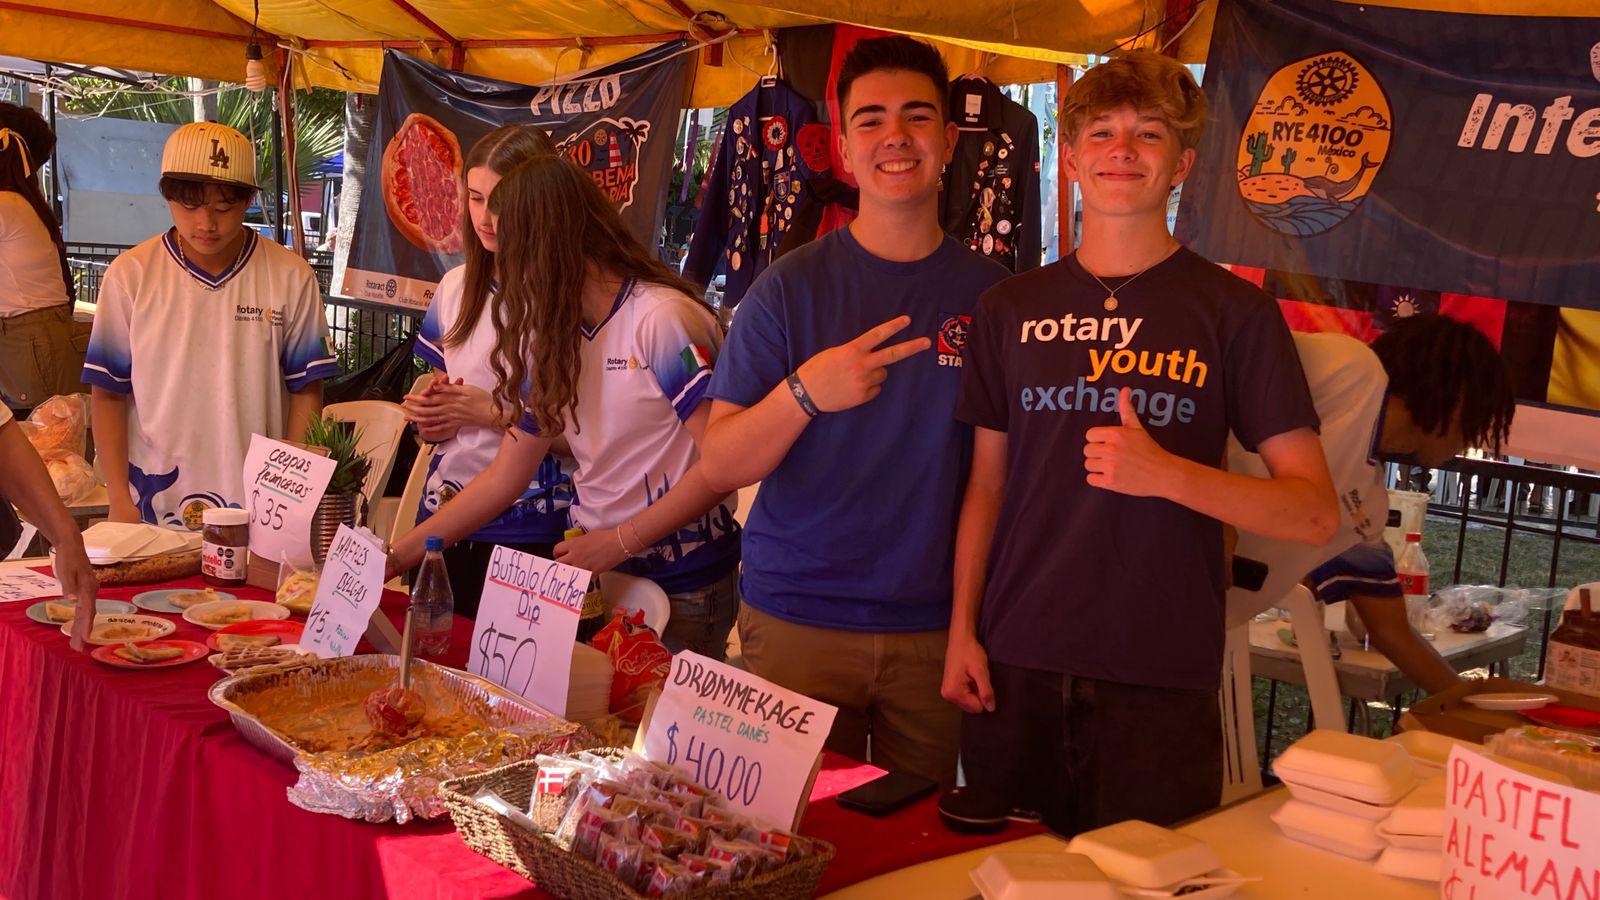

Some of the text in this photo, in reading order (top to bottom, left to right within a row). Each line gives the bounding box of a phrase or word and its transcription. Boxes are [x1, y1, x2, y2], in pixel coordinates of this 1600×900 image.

[1272, 121, 1363, 147] RYE 4100
[1317, 144, 1356, 158] México
[209, 139, 229, 169] LA
[1020, 313, 1143, 349] rotary
[1086, 349, 1208, 388] youth
[1020, 376, 1196, 427] exchange
[491, 547, 540, 589] Buffalo
[518, 590, 540, 630] Dip
[674, 658, 815, 734] DRØMMEKAGE
[693, 706, 732, 733] PASTEL
[1452, 757, 1580, 849] PASTEL
